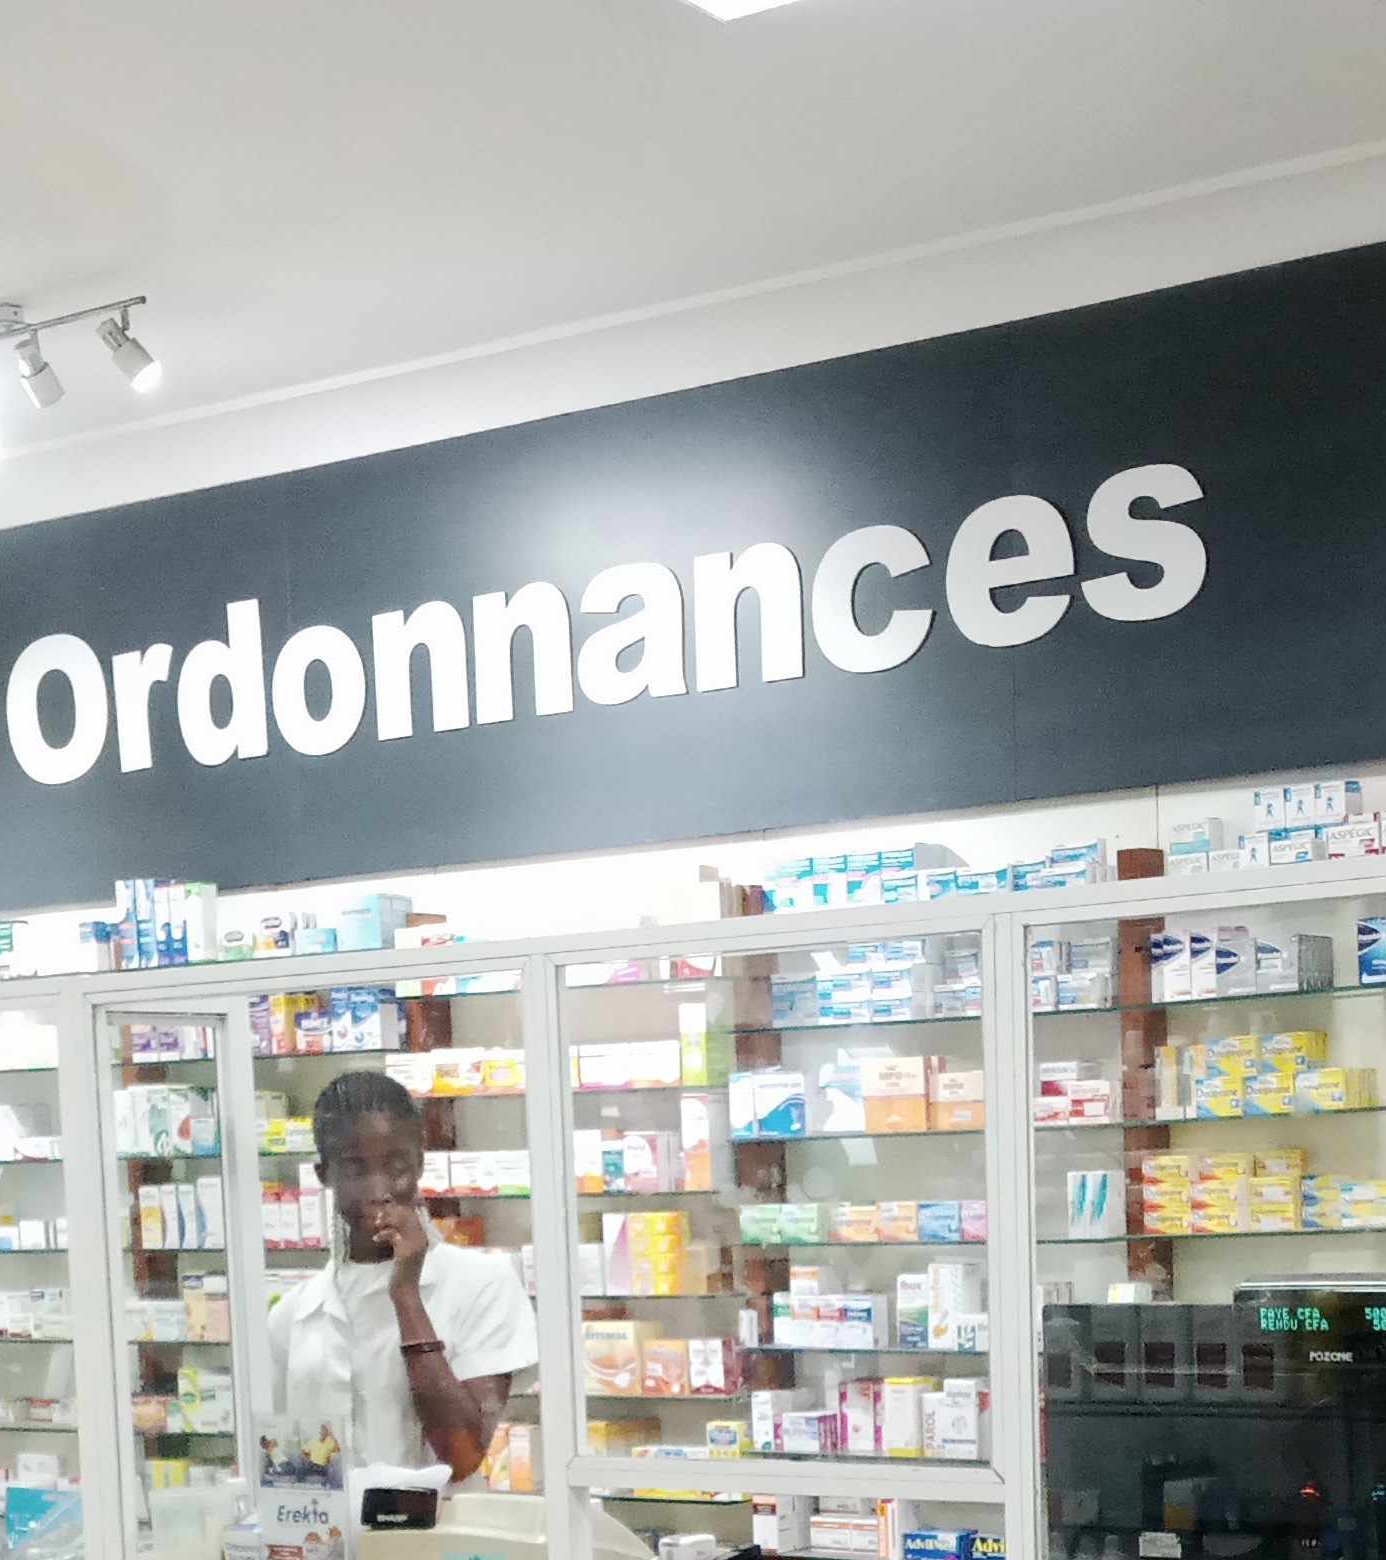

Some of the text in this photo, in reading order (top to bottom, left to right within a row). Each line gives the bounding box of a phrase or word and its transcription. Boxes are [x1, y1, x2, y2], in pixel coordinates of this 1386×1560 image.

[4, 462, 1209, 787] Ordonnances
[1329, 827, 1373, 839] ASPÉGIC
[1259, 1307, 1290, 1320] PAYE
[1297, 1307, 1321, 1320] CFA
[1260, 1319, 1298, 1331] RENDU
[1305, 1319, 1329, 1331] CFA
